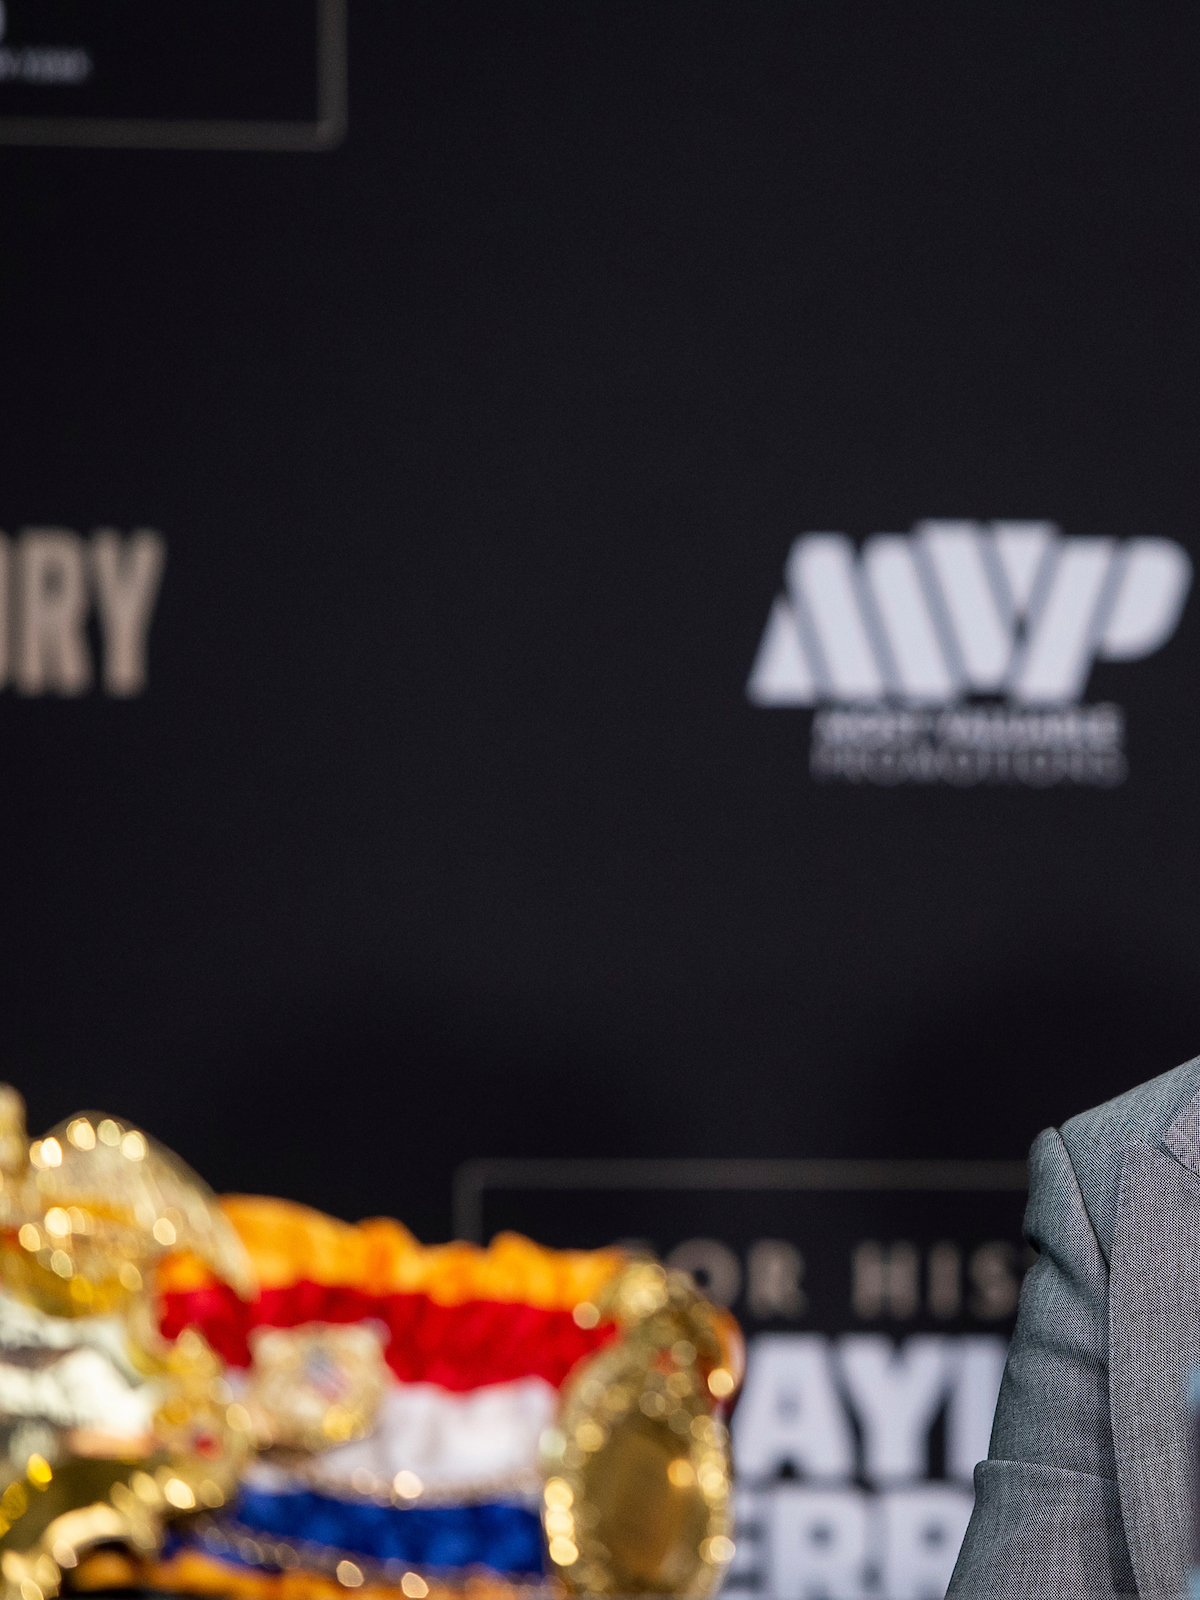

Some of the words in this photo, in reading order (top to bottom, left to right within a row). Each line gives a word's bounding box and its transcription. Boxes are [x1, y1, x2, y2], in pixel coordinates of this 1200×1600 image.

[0, 527, 167, 697] RY
[747, 517, 1196, 708] MVP
[645, 1238, 804, 1318] OR
[849, 1238, 1027, 1318] HIS
